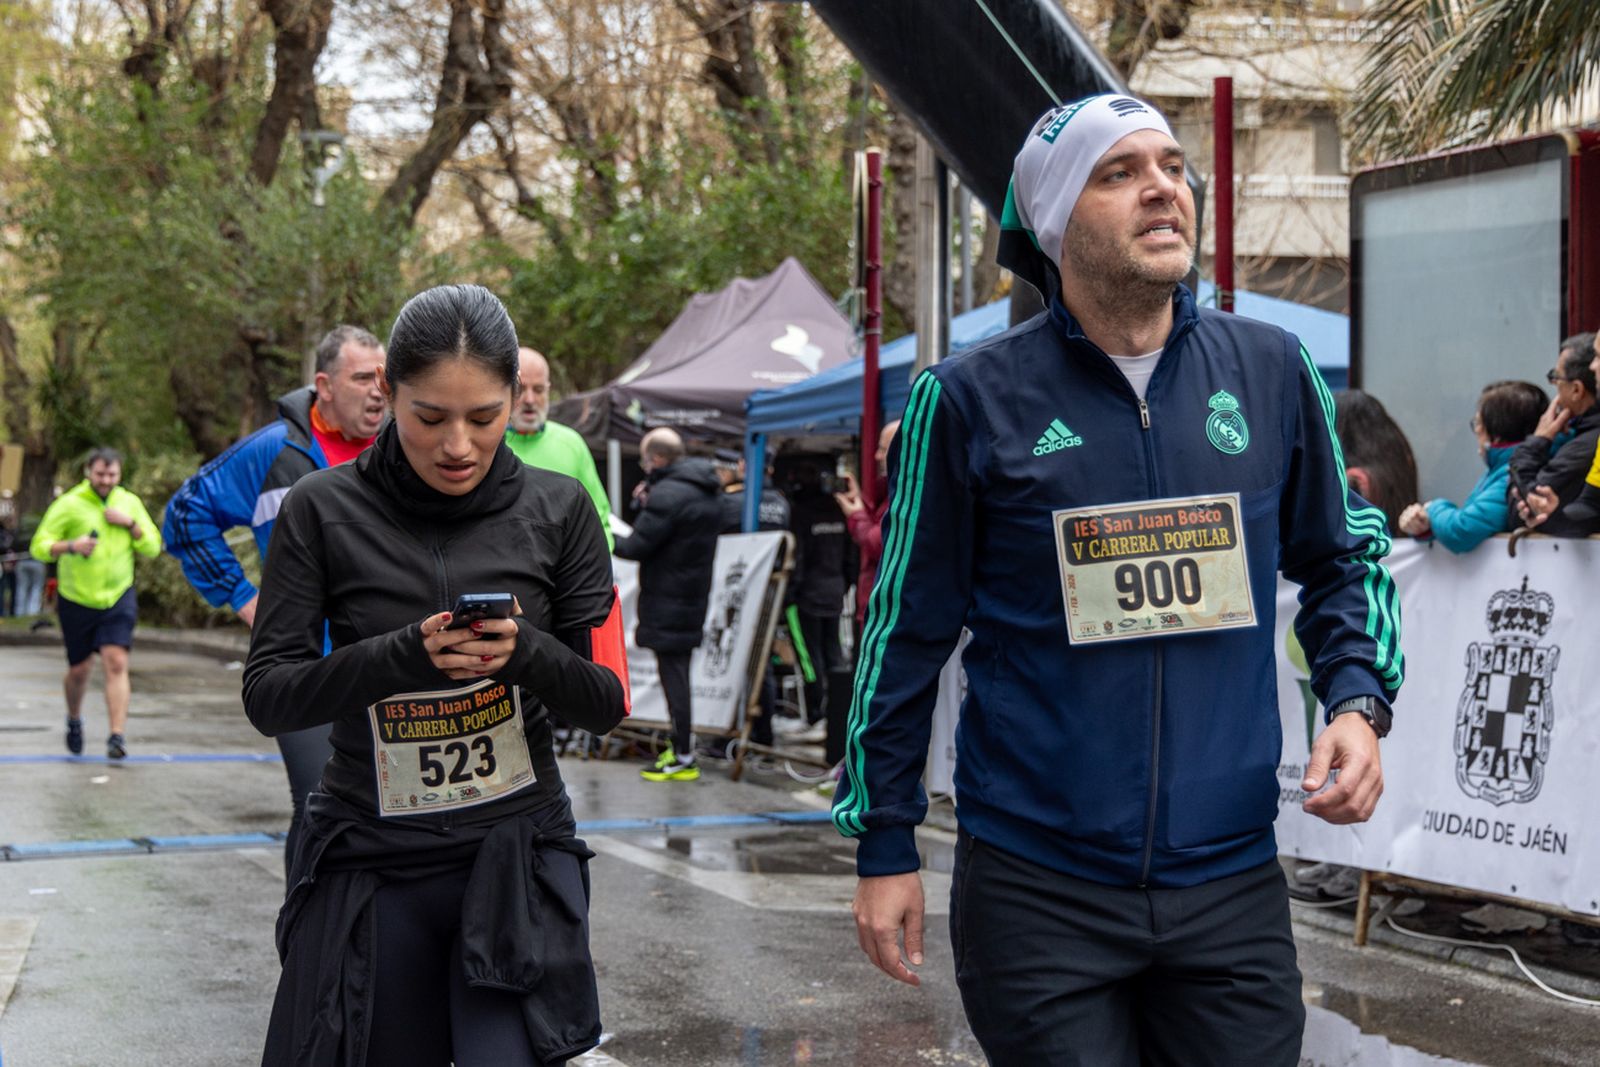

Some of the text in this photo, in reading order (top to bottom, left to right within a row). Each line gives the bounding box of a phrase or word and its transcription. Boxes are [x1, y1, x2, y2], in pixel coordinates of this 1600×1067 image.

[1033, 436, 1082, 456] adidas
[1074, 509, 1222, 537] IES San Juan Bosco
[1072, 527, 1230, 560] V CARRERA POPULAR
[1114, 557, 1202, 612] 900
[385, 684, 506, 719] IES San Juan Bosco
[384, 699, 512, 739] V CARRERA POPULAR
[419, 735, 497, 788] 523
[1492, 821, 1515, 846] DE
[1520, 823, 1567, 855] JAÉN
